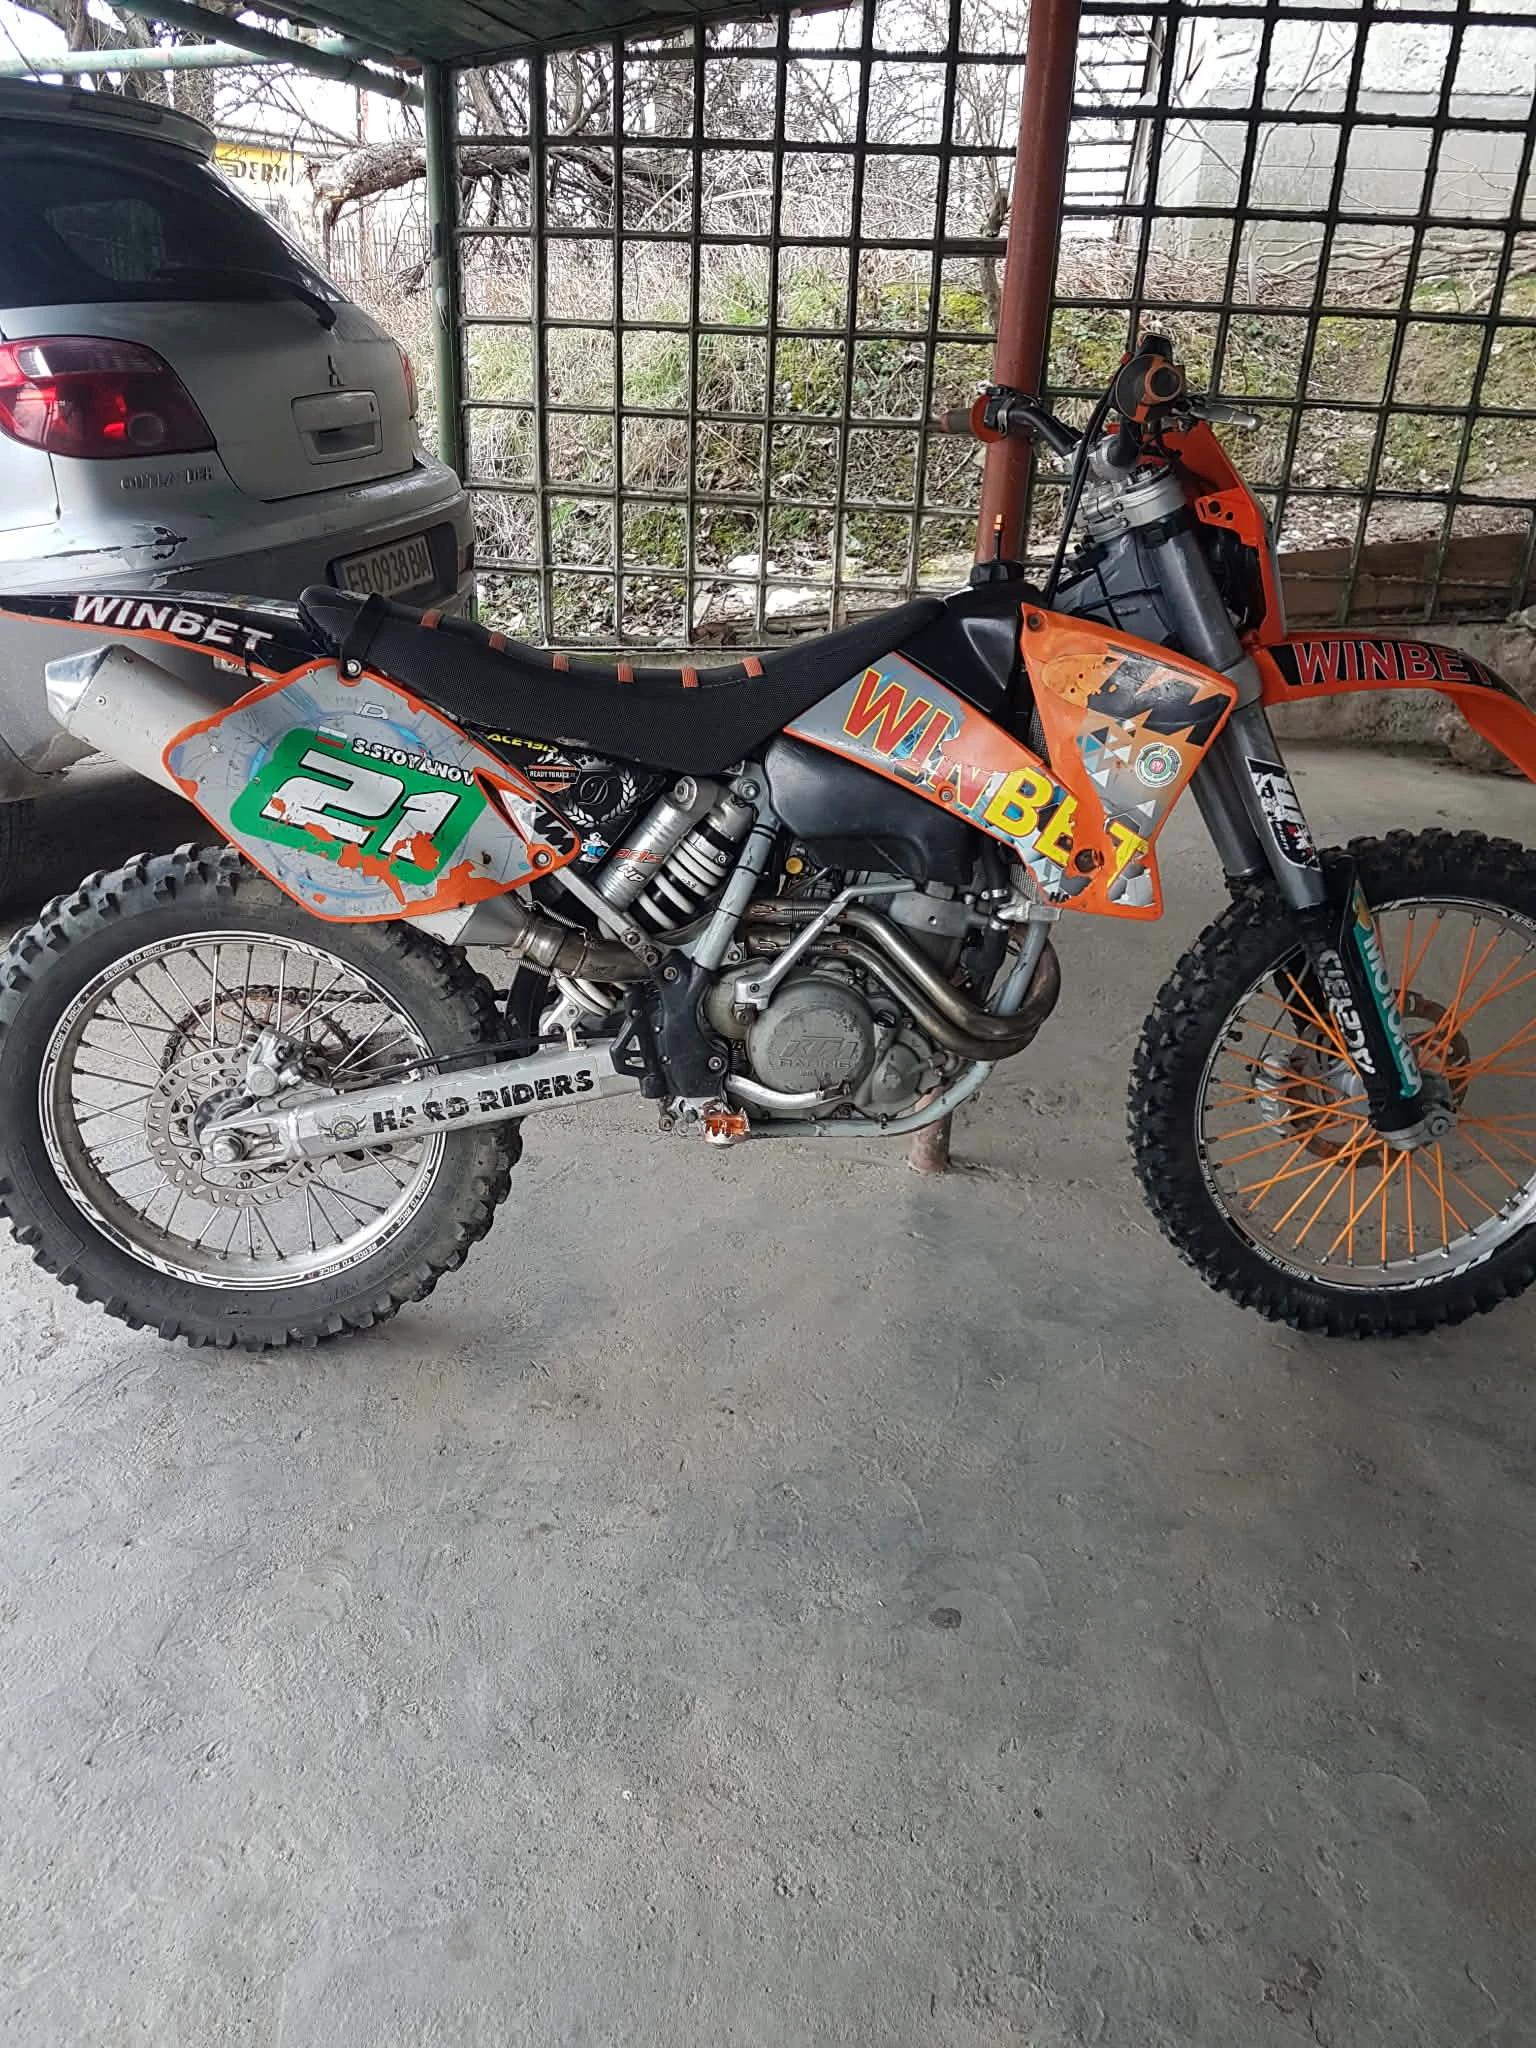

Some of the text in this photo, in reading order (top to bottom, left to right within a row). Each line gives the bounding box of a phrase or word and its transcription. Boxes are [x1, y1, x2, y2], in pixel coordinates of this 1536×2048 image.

[73, 595, 273, 652] WINBET
[1292, 641, 1493, 686] WINBET
[529, 770, 548, 778] READY
[260, 749, 461, 865] 21
[129, 952, 142, 964] TO
[142, 943, 167, 959] RACE
[373, 1069, 594, 1133] HARD RIDERS
